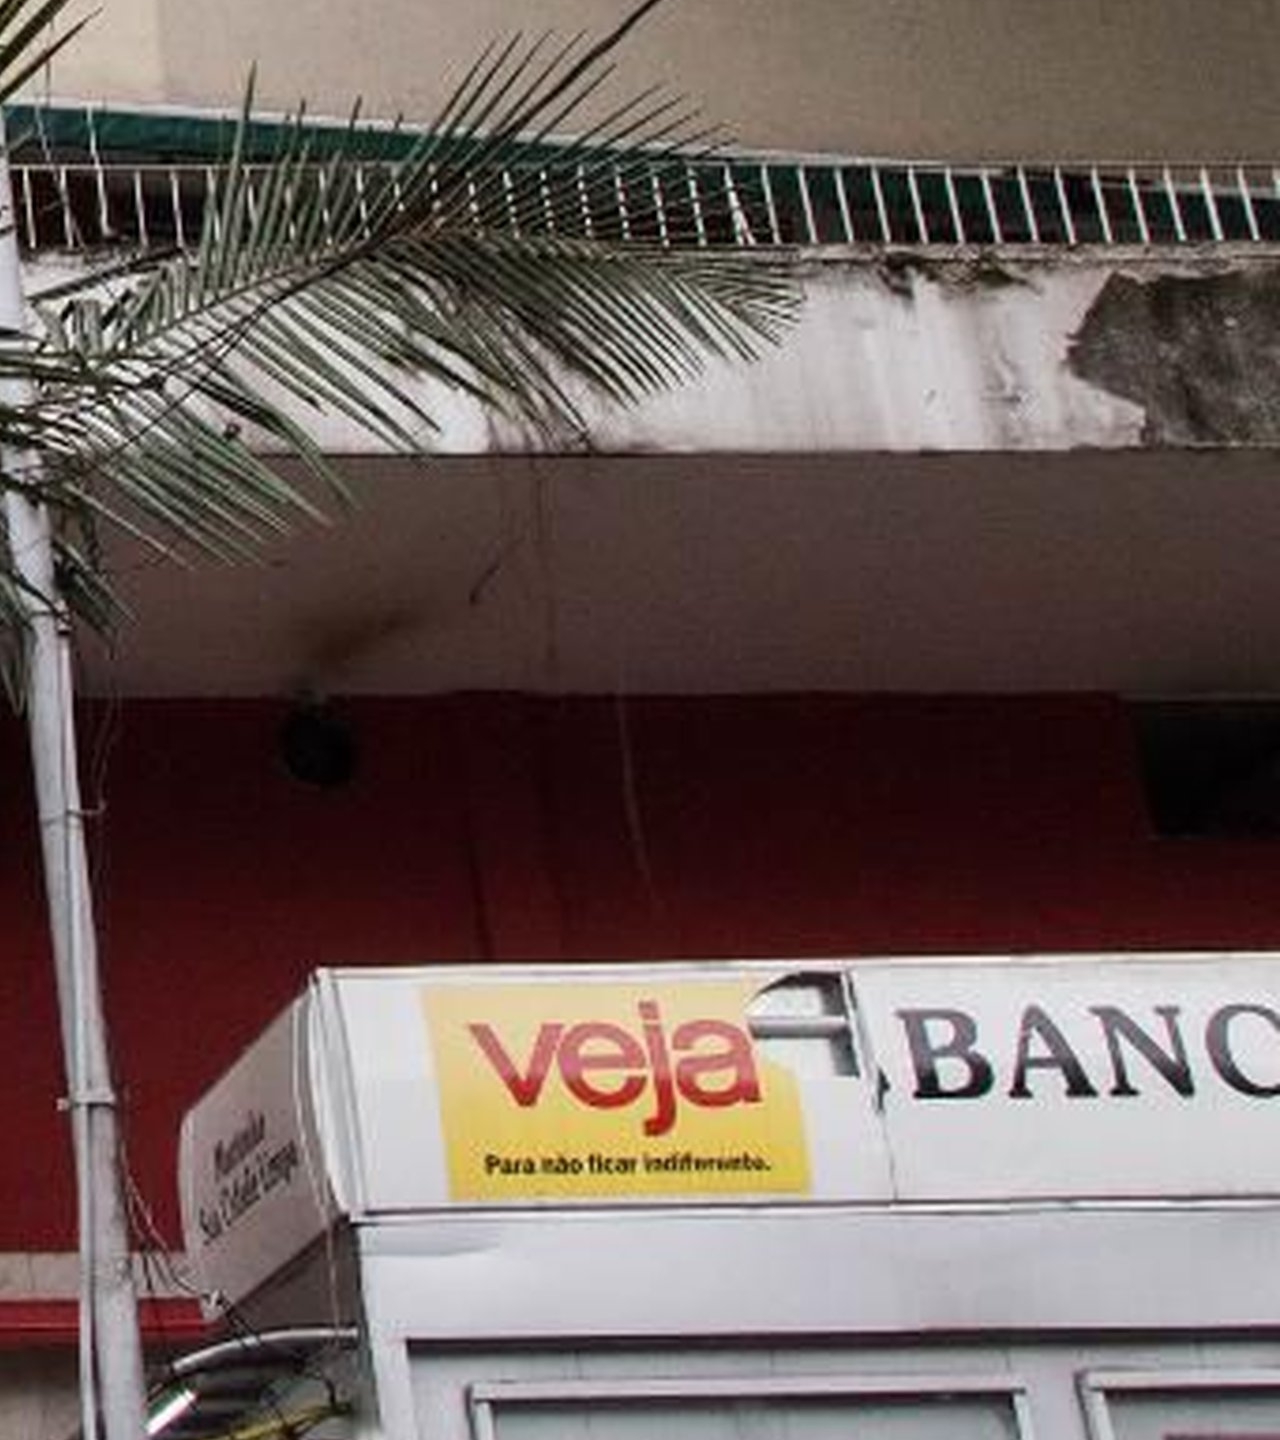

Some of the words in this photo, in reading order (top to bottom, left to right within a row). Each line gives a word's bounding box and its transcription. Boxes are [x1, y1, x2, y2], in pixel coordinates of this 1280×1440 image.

[468, 1000, 763, 1136] veja
[484, 1154, 536, 1175] Para
[542, 1153, 583, 1174] não
[587, 1152, 638, 1173] ficar
